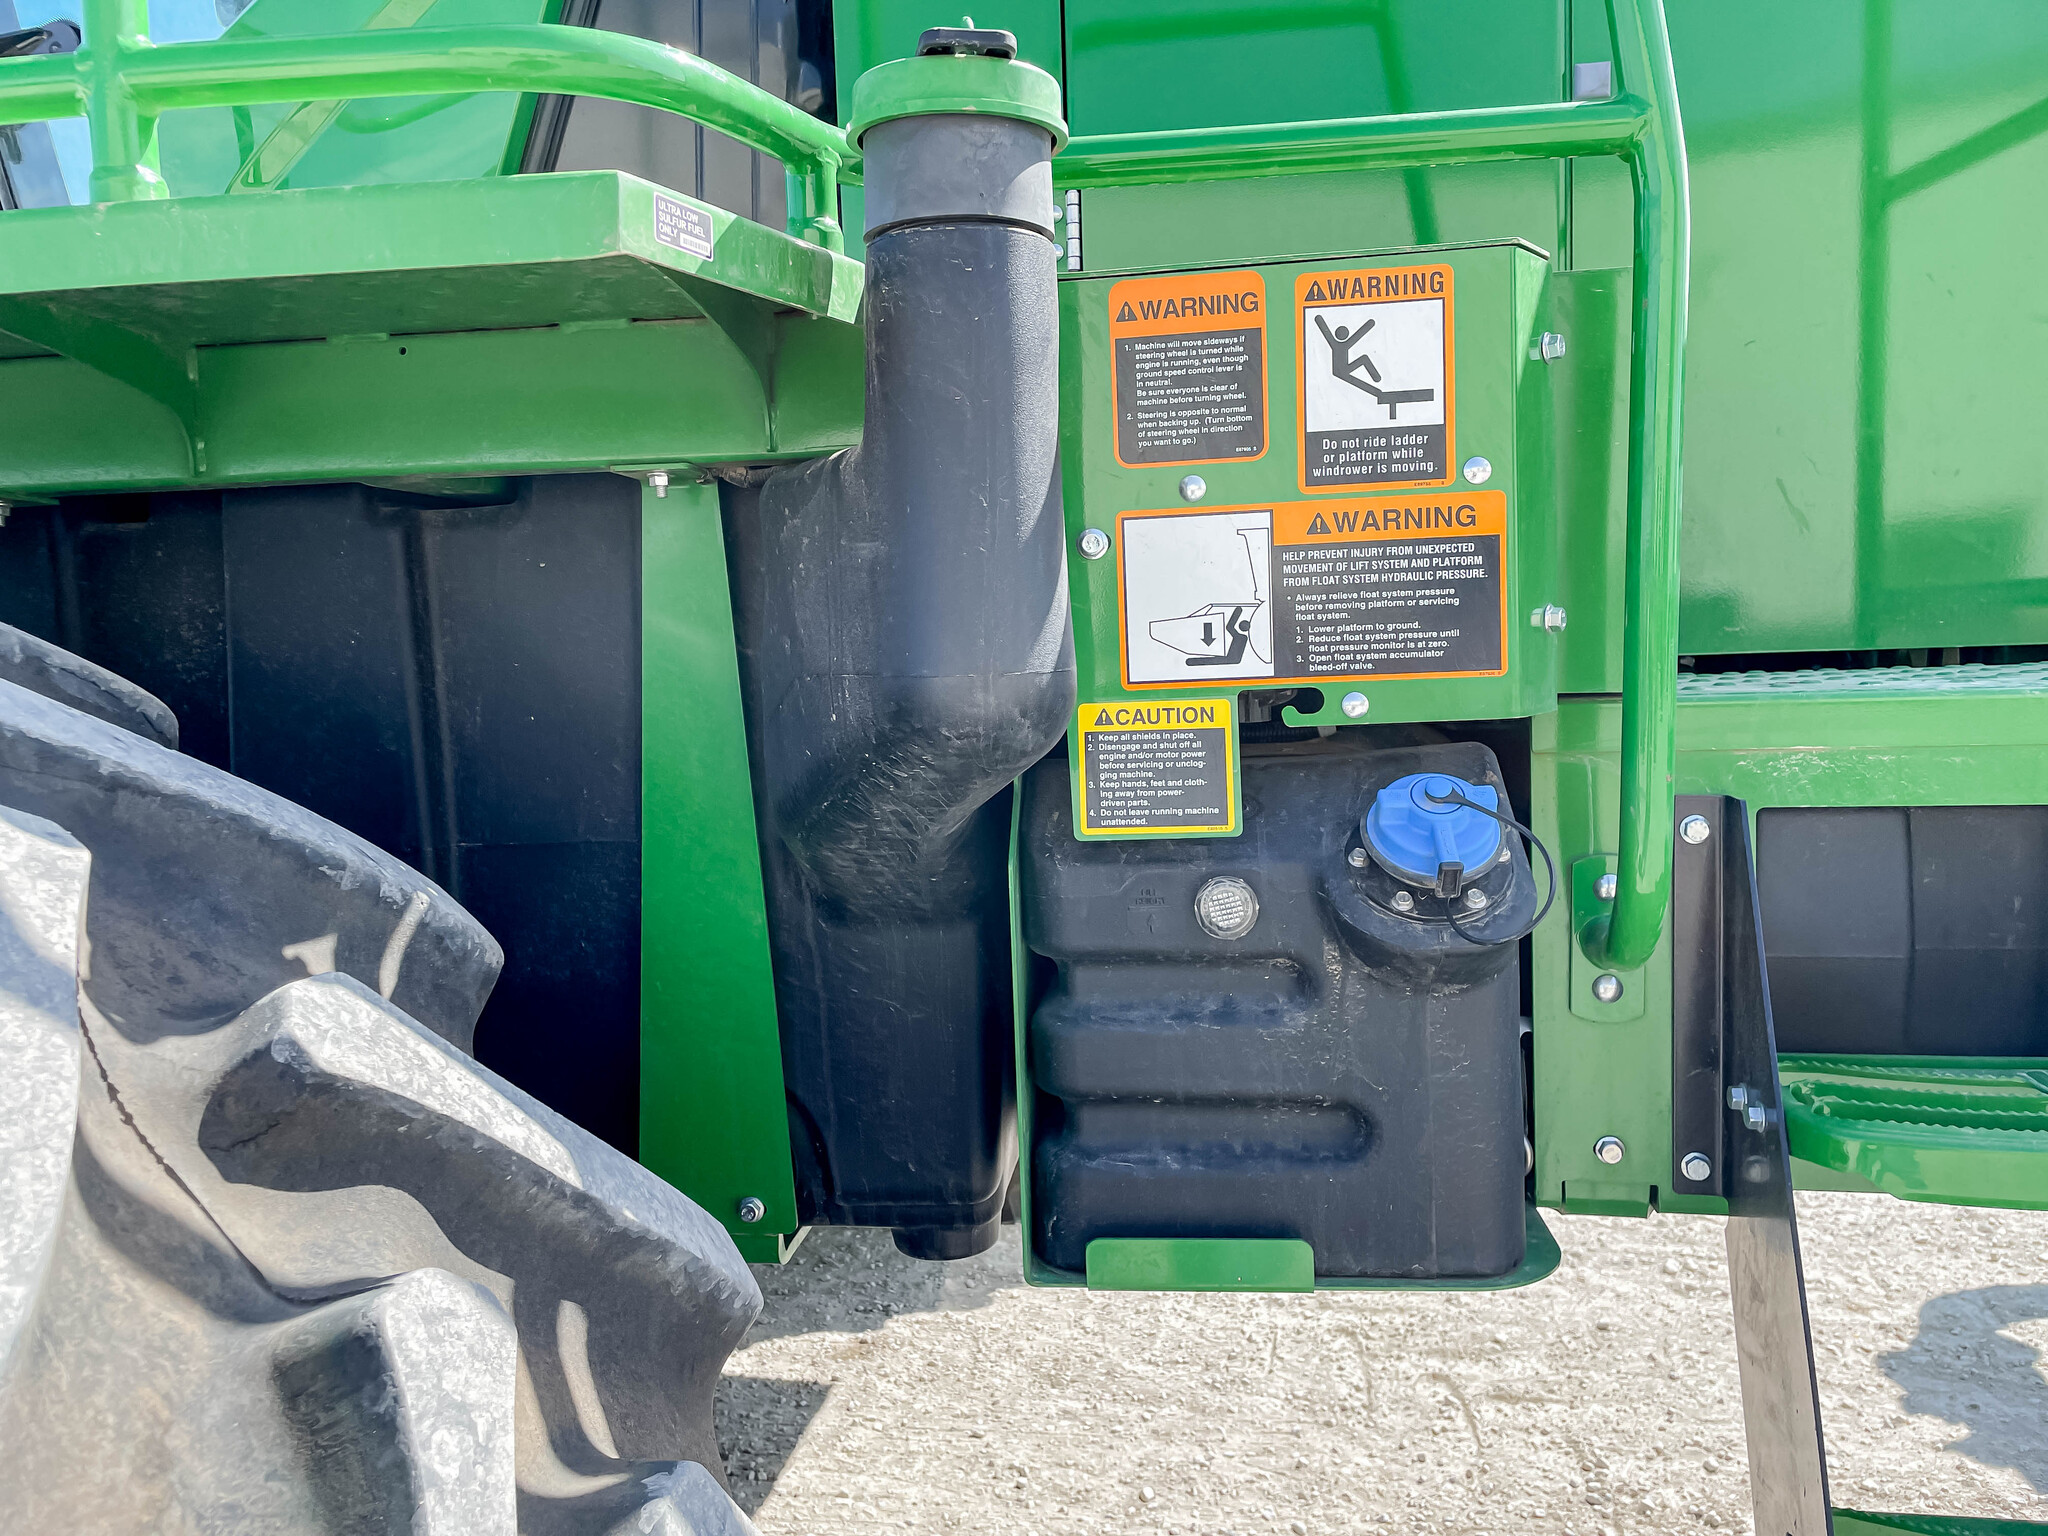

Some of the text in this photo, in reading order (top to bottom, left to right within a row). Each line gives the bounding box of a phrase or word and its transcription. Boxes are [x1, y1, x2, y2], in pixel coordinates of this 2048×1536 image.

[658, 199, 698, 224] ULTRA LOW
[658, 210, 686, 230] SULFUR
[687, 222, 705, 238] FUEL
[658, 222, 678, 238] ONLY
[1327, 271, 1444, 300] WARNING
[1138, 291, 1258, 320] WARNING
[1135, 341, 1165, 350] Machine
[1203, 337, 1238, 345] sideways
[1135, 345, 1244, 360] steering wheel turned while
[1135, 361, 1160, 370] engine
[1170, 358, 1201, 366] running,
[1222, 354, 1248, 363] though
[1135, 369, 1162, 380] ground
[1164, 368, 1186, 377] speed
[1187, 366, 1214, 374] control
[1145, 378, 1172, 387] neutral.
[1166, 386, 1200, 395] everyone
[1136, 397, 1168, 406] machine
[1194, 394, 1221, 402] turning
[1222, 391, 1246, 400] wheel.
[1137, 410, 1167, 419] Steering
[1177, 408, 1210, 418] opposite
[1220, 405, 1246, 413] normal
[1158, 418, 1187, 427] backing
[1204, 416, 1224, 425] (Turn
[1147, 428, 1176, 437] steering
[1178, 426, 1200, 435] wheel
[1210, 424, 1242, 433] direction
[1182, 436, 1196, 445] go.)
[1322, 433, 1428, 450] Do not ride ladder
[1323, 447, 1423, 464] or platform while
[1312, 460, 1438, 477] windrower is moving.
[1332, 504, 1476, 533] WARNING
[1282, 542, 1474, 561] HELP PREVENT INJURY FROM UNEXPECTED
[1283, 555, 1482, 574] MOVEMENT OF LIFT SYSTEM AND PLATFORM
[1283, 568, 1488, 587] FROM FLOAT SYSTEM HYDRAULIC PRESSURE.
[1295, 593, 1326, 602] Always
[1360, 590, 1379, 598] float
[1381, 589, 1413, 599] system
[1415, 588, 1455, 598] pressure
[1295, 597, 1459, 611] before removing platform servicing
[1295, 612, 1350, 621] float system.
[1337, 623, 1373, 633] platform
[1386, 621, 1421, 631] ground.
[1308, 629, 1459, 642] Reduce float system pressure until
[1308, 644, 1328, 652] float
[1330, 643, 1368, 653] pressure
[1371, 641, 1405, 650] monitor
[1308, 649, 1444, 663] Open float system accumulator
[1309, 663, 1347, 671] bleed-off
[1115, 706, 1214, 725] CAUTION
[1098, 734, 1118, 742] Keep
[1132, 732, 1160, 740] shields
[1172, 732, 1196, 741] place.
[1098, 743, 1140, 752] Disengage
[1098, 752, 1126, 761] engine
[1181, 751, 1206, 759] power
[1126, 761, 1163, 770] servicing
[1175, 760, 1206, 768] unclog-
[1099, 770, 1155, 780] ging machine.
[1099, 781, 1120, 789] Keep
[1100, 790, 1112, 799] ing
[1114, 790, 1135, 798] away
[1157, 789, 1184, 798] power-
[1127, 799, 1150, 808] parts.
[1151, 807, 1182, 816] running
[1100, 817, 1148, 826] unattended.
